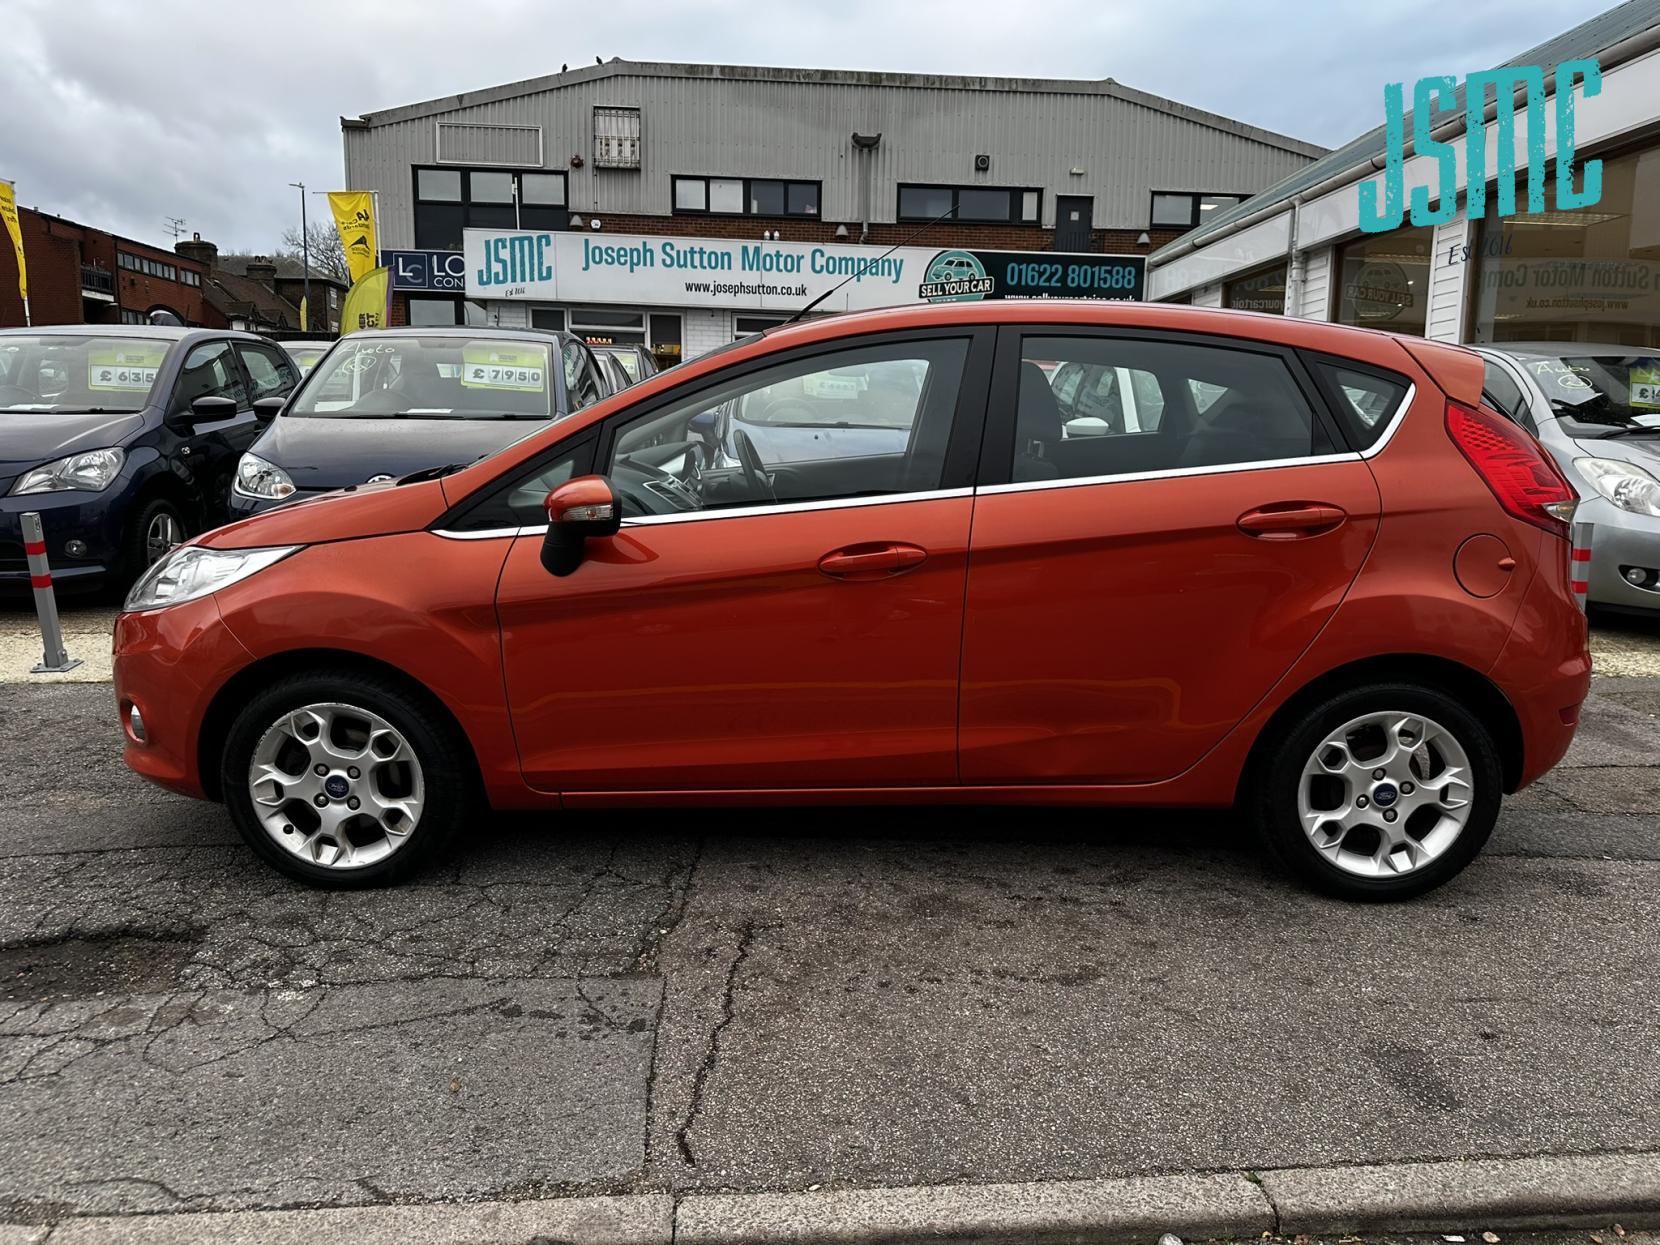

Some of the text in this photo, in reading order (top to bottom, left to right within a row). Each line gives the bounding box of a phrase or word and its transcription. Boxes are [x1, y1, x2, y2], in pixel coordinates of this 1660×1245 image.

[433, 254, 465, 277] LO
[477, 234, 552, 287] JSMC
[582, 238, 904, 284] Joseph Sutton Motor Company
[433, 277, 464, 288] CON
[1006, 262, 1136, 289] 01622 801588
[684, 280, 808, 298] www.josephsutton.co.uk
[921, 279, 991, 297] SELL YOUR CAR
